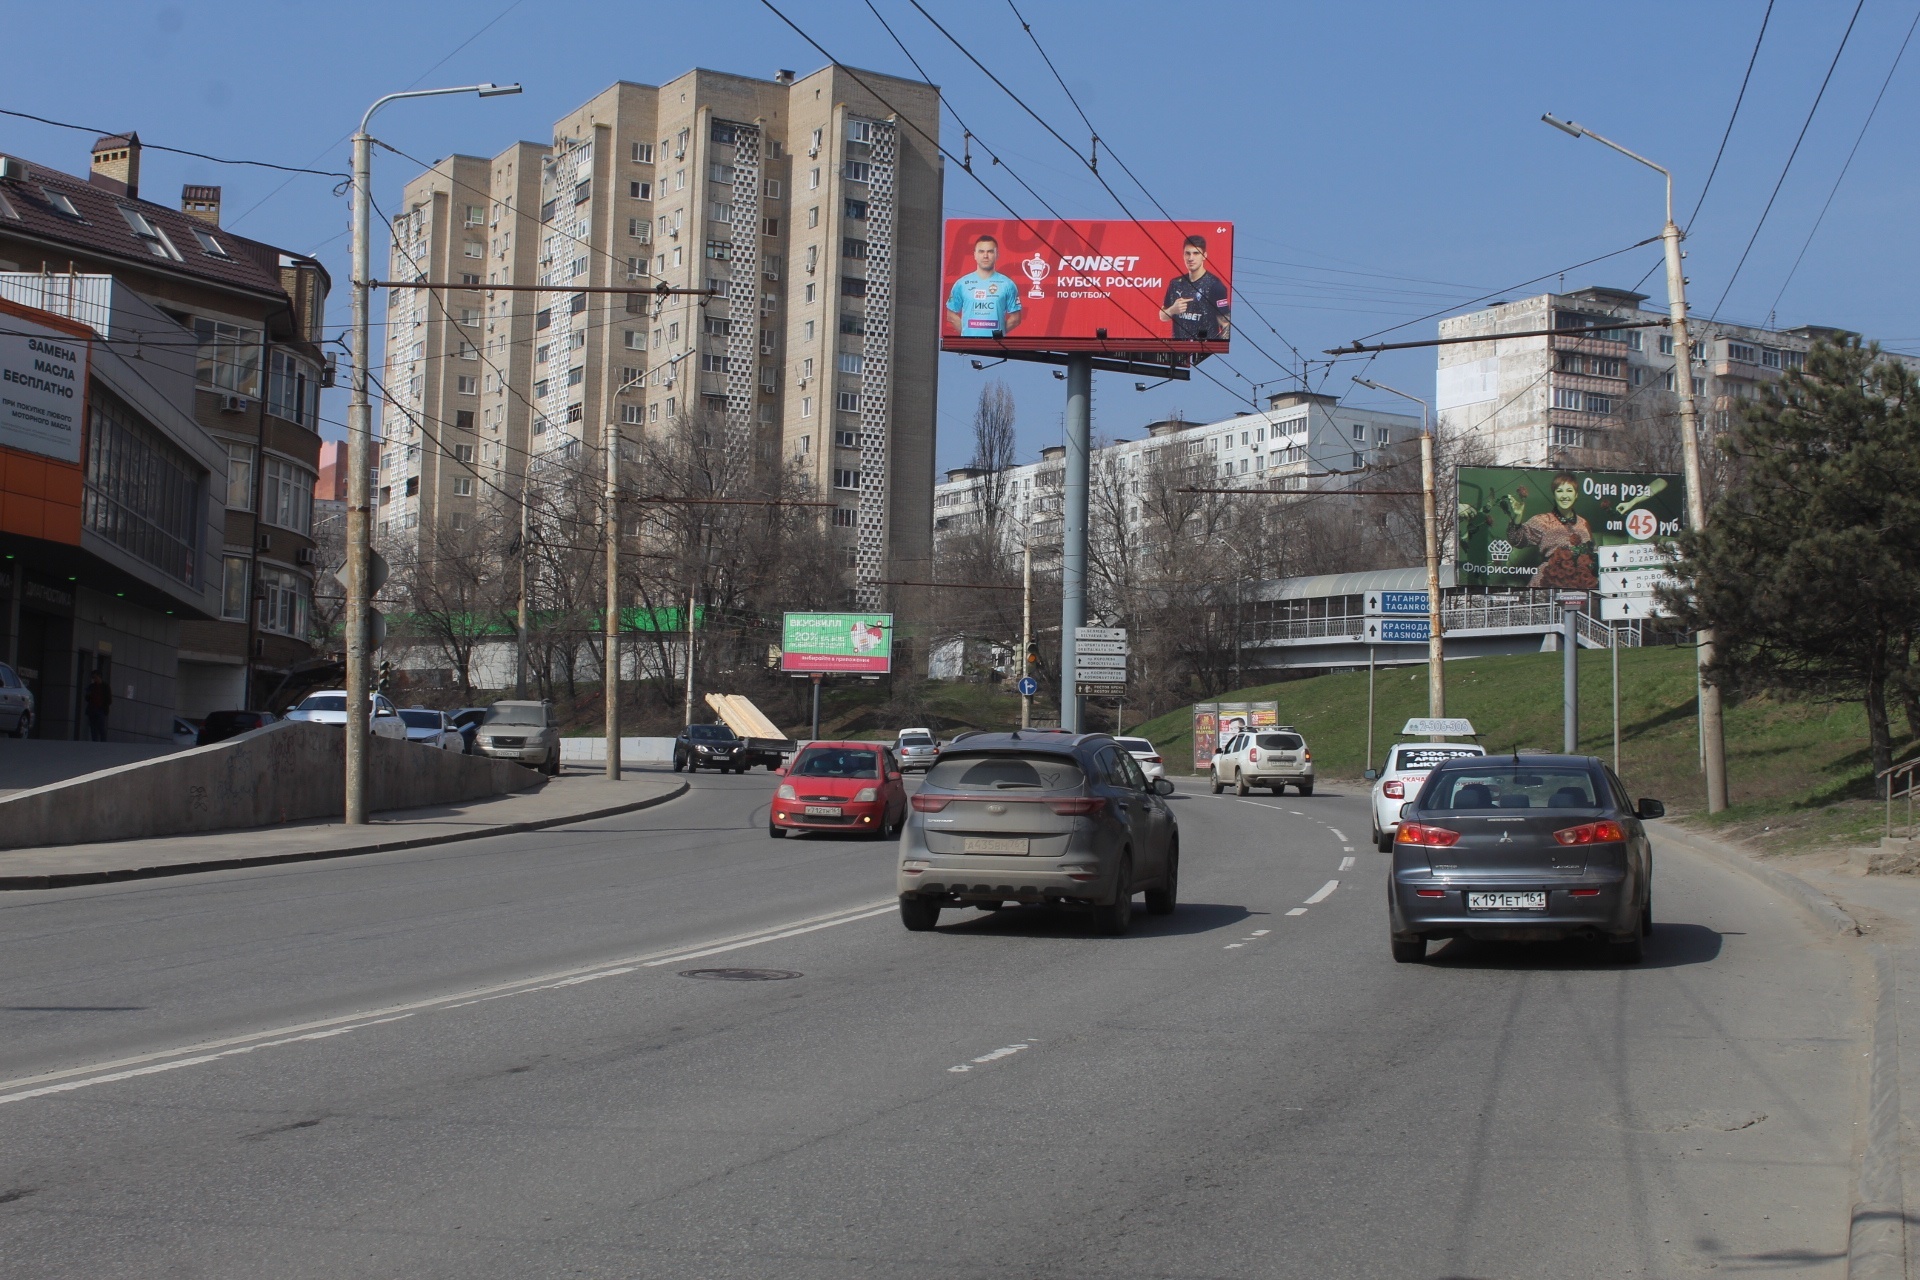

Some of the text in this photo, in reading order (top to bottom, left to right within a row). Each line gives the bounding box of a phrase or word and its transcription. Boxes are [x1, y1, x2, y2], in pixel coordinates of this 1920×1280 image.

[1216, 226, 1227, 234] 6+
[1058, 255, 1140, 272] FONBET
[1057, 276, 1162, 288] КУБОК РОССИИ
[1057, 291, 1111, 299] ПО ФУТБОЛУ
[975, 302, 994, 310] ИКС
[28, 338, 77, 363] ЗАМЕНА
[34, 359, 76, 381] МАСЛА
[3, 368, 74, 399] БЕСПЛАТНО
[2, 398, 73, 423] ПРИ ПОКУПКЕ ЛЮБОГО
[11, 410, 72, 432] МОТОРНОГО МАСЛА
[1583, 477, 1651, 501] Одна роза
[1606, 514, 1682, 536] от 45 руб.
[1462, 561, 1538, 576] Флориссима
[790, 619, 842, 627] ВКУСВИЛЛ
[1382, 622, 1431, 631] КРАСНОДА
[1419, 720, 1468, 732] 2-306-306
[1473, 892, 1542, 906] К191ЕТ 161
